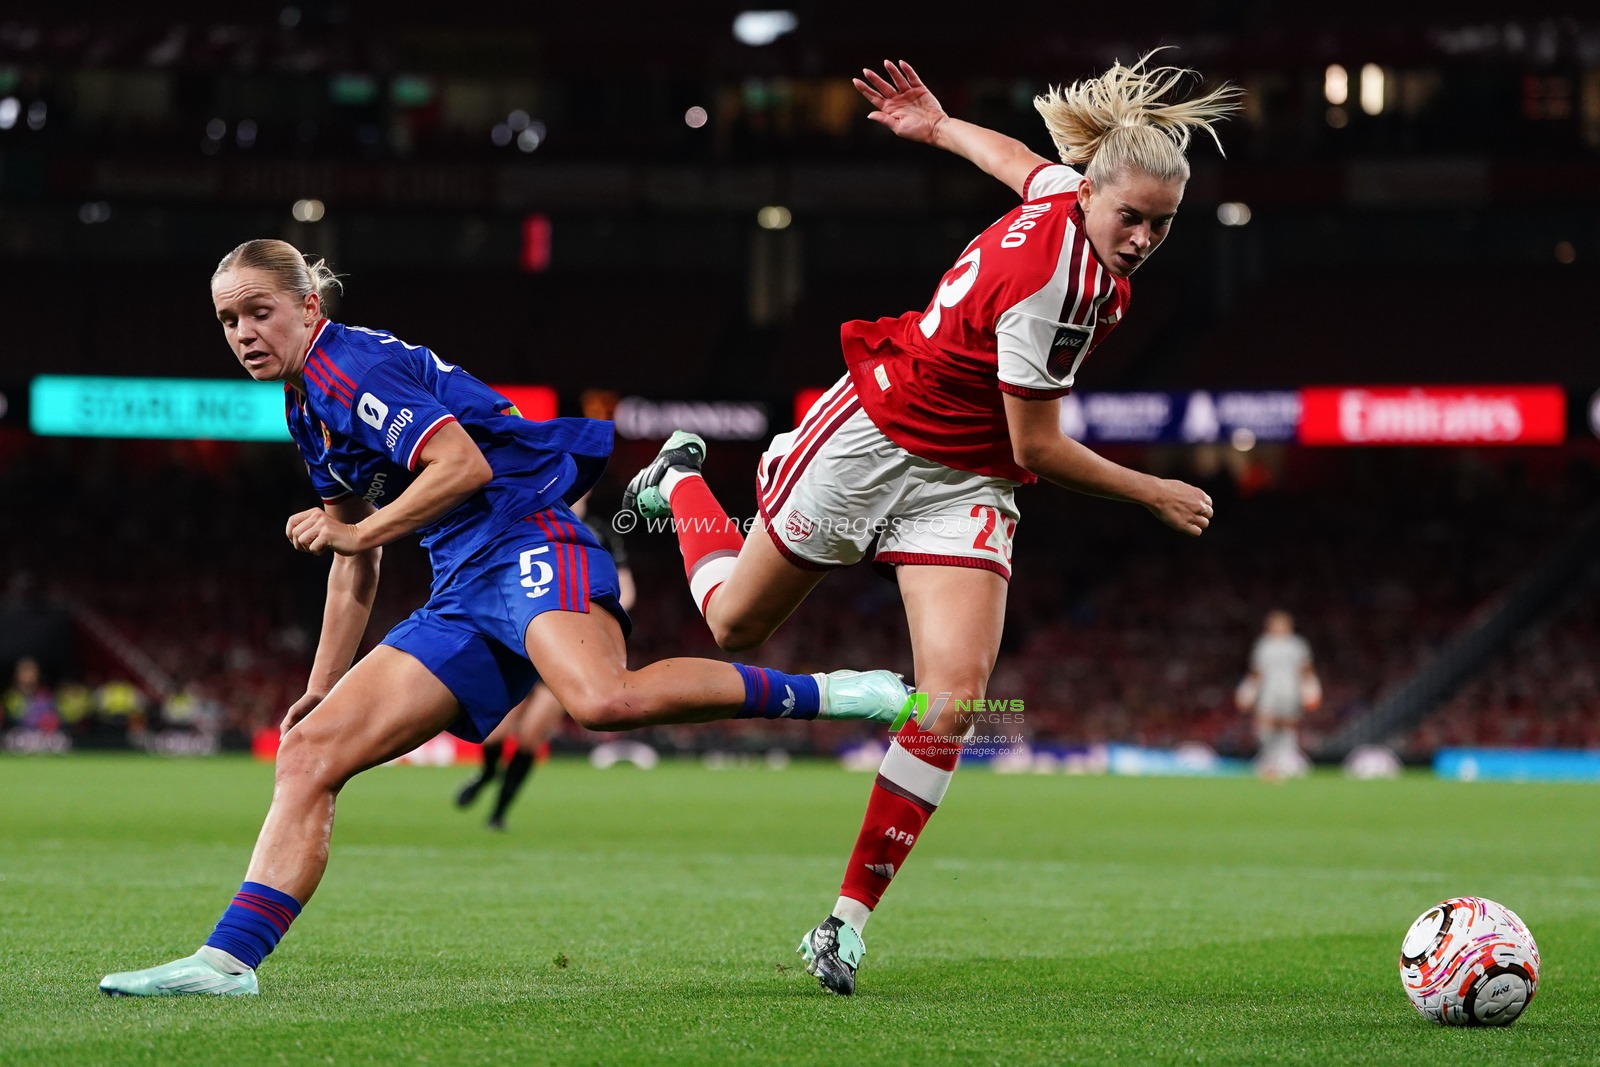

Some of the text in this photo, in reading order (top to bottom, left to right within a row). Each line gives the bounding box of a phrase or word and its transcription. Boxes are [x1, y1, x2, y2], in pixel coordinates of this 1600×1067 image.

[385, 407, 414, 452] sumup
[1340, 387, 1521, 442] Emirates
[519, 545, 554, 588] 5
[884, 826, 915, 846] AFC
